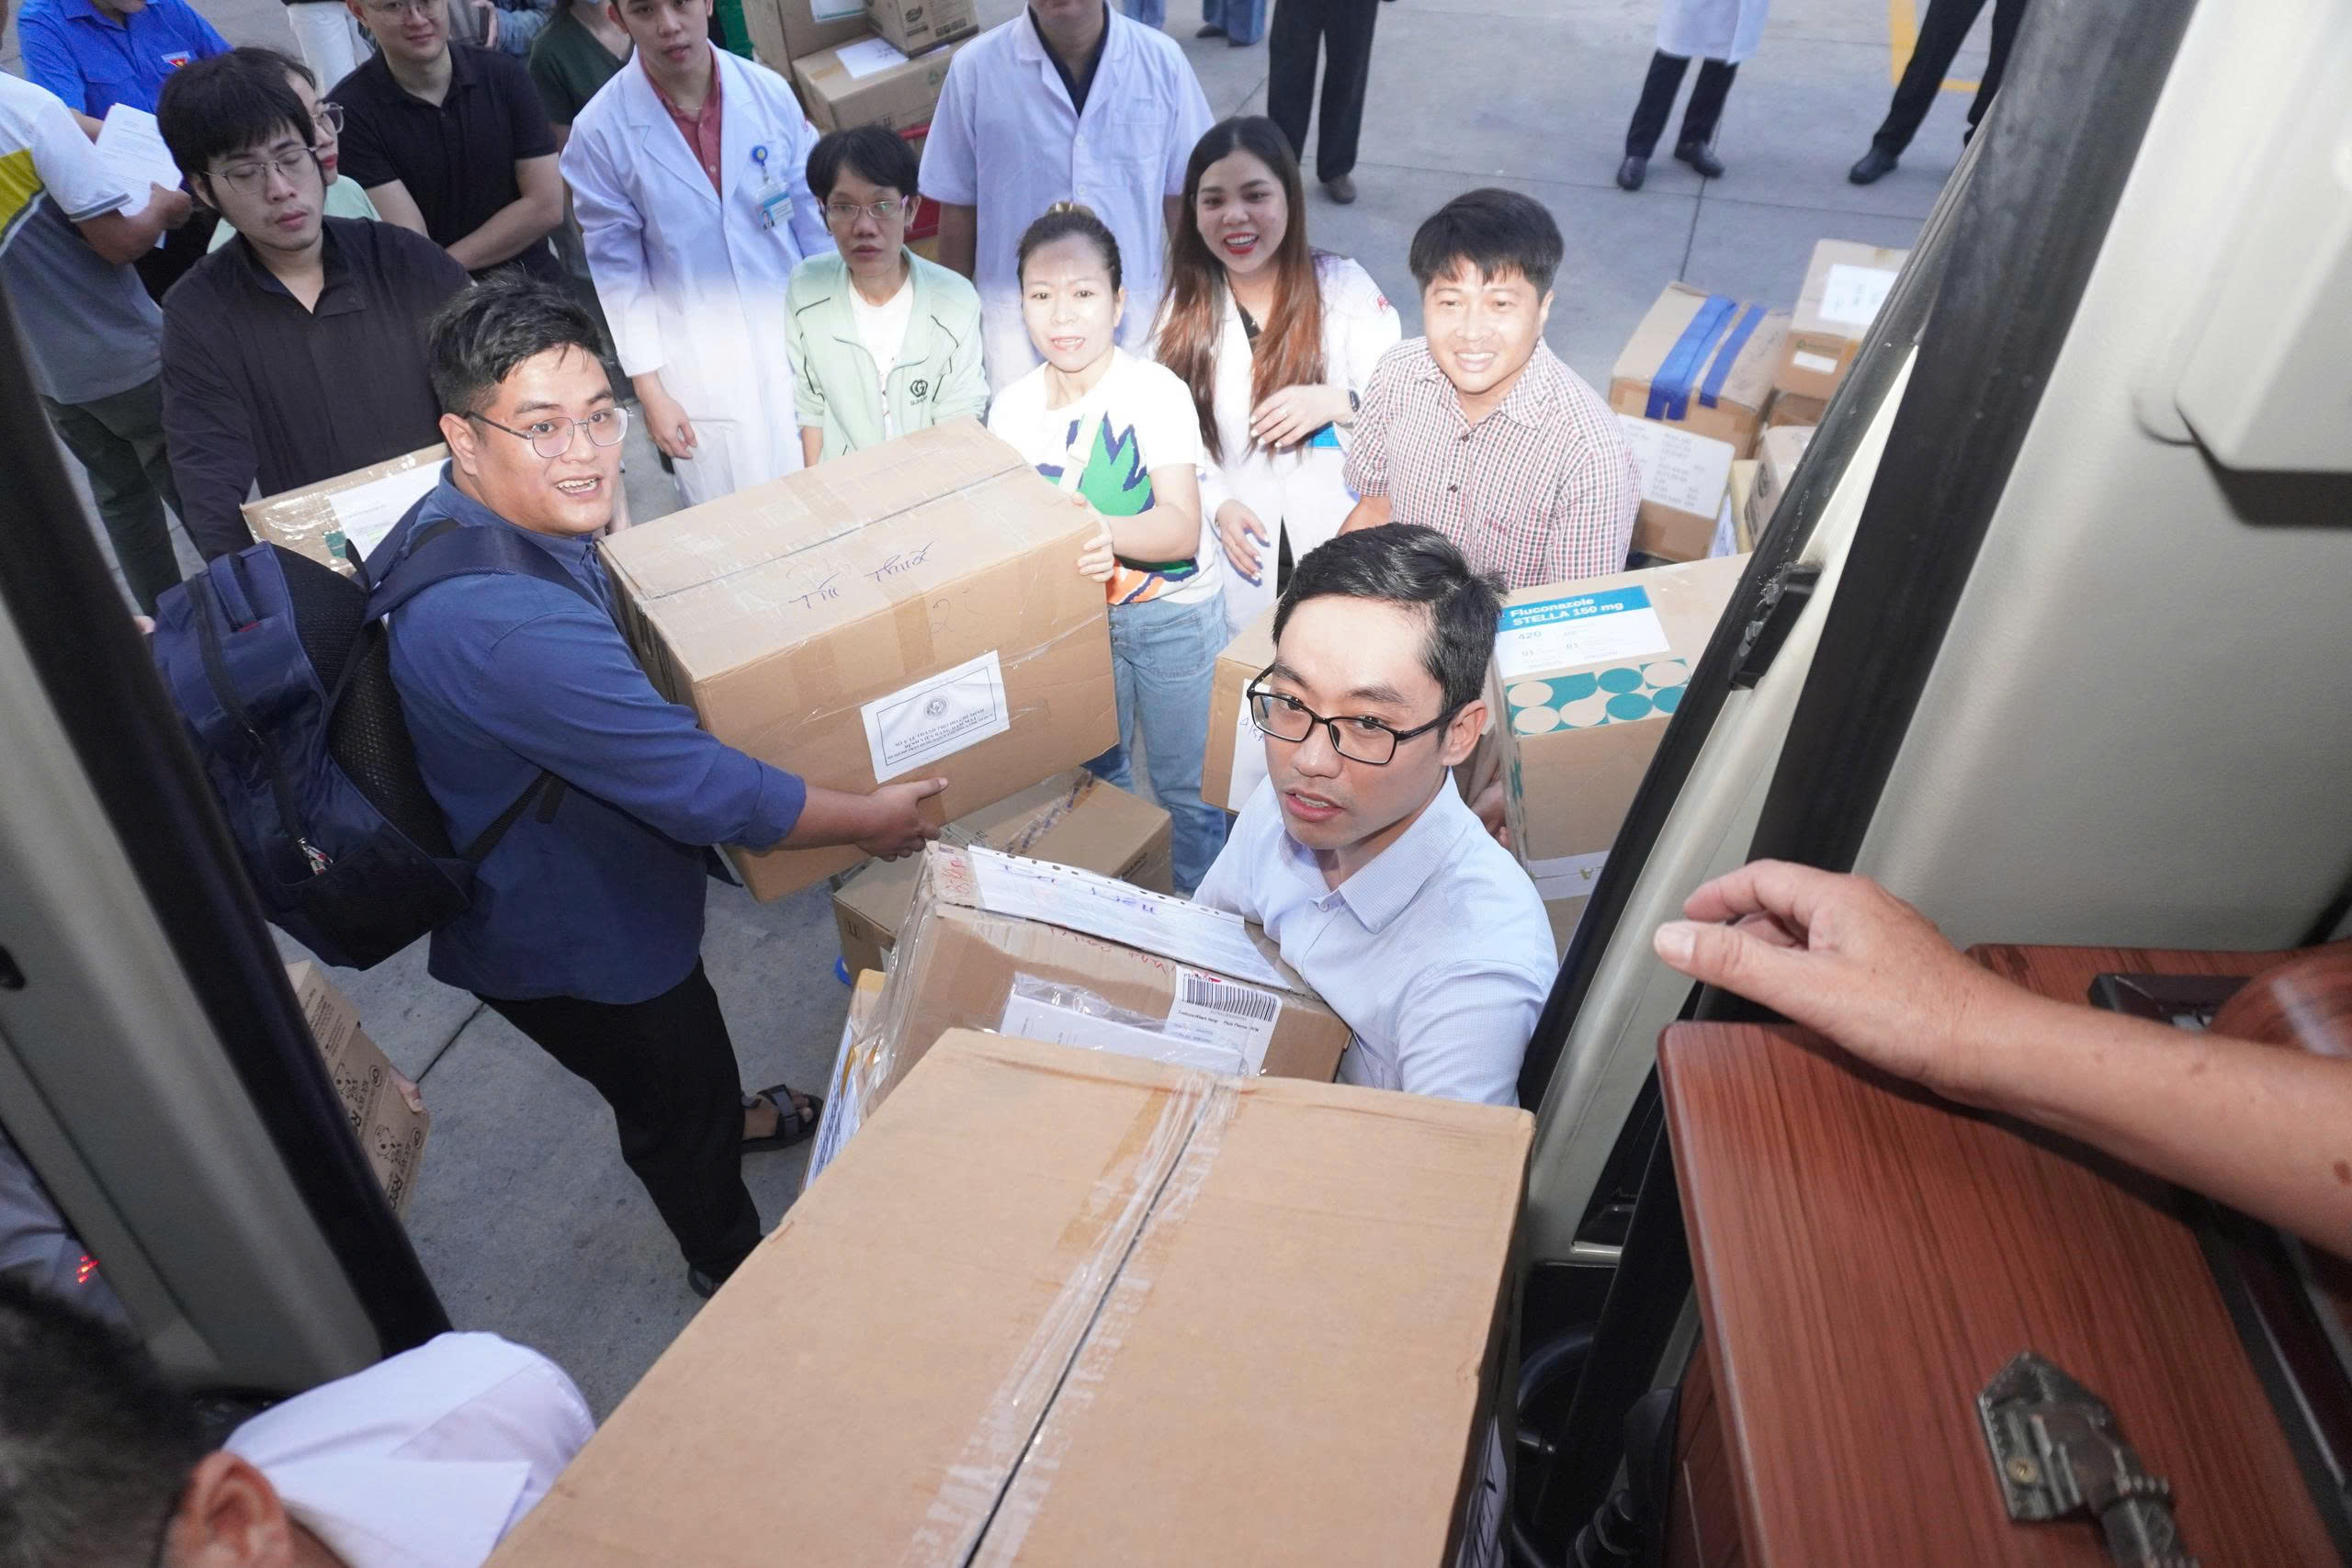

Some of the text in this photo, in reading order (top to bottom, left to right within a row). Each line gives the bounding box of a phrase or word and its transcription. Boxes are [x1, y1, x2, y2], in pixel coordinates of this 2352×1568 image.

[1510, 598, 1594, 617] Fluconazole
[1513, 602, 1624, 626] STELLA 150 mg
